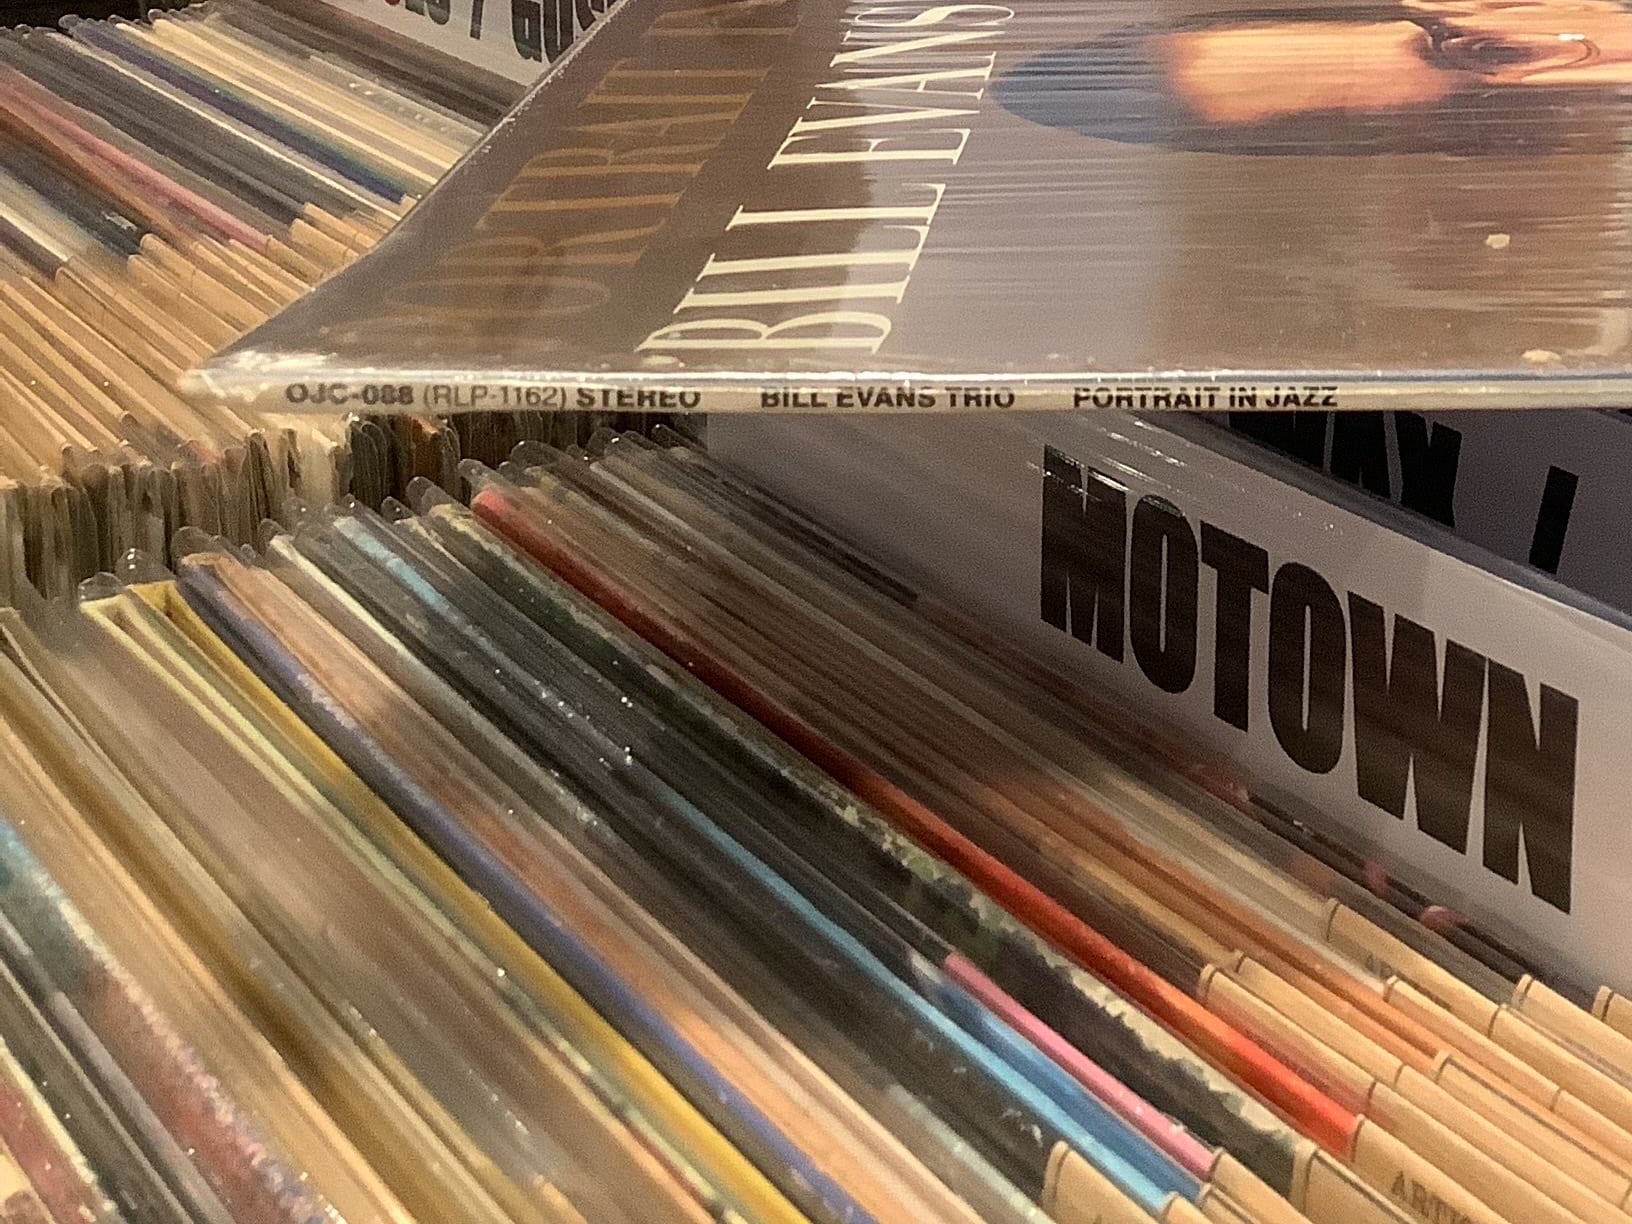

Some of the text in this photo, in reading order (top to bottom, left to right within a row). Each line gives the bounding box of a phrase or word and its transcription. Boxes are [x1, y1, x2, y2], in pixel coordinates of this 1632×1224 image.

[634, 4, 1014, 354] BILL EVANS
[421, 383, 568, 411] (RLP-1162)
[576, 384, 701, 409] STEREO
[761, 386, 1015, 410] BILL EVANS TRIO
[1074, 386, 1339, 409] PORTRAIT IN JAZZ
[1528, 464, 1579, 575] /
[1041, 444, 1579, 915] MOTOWN
